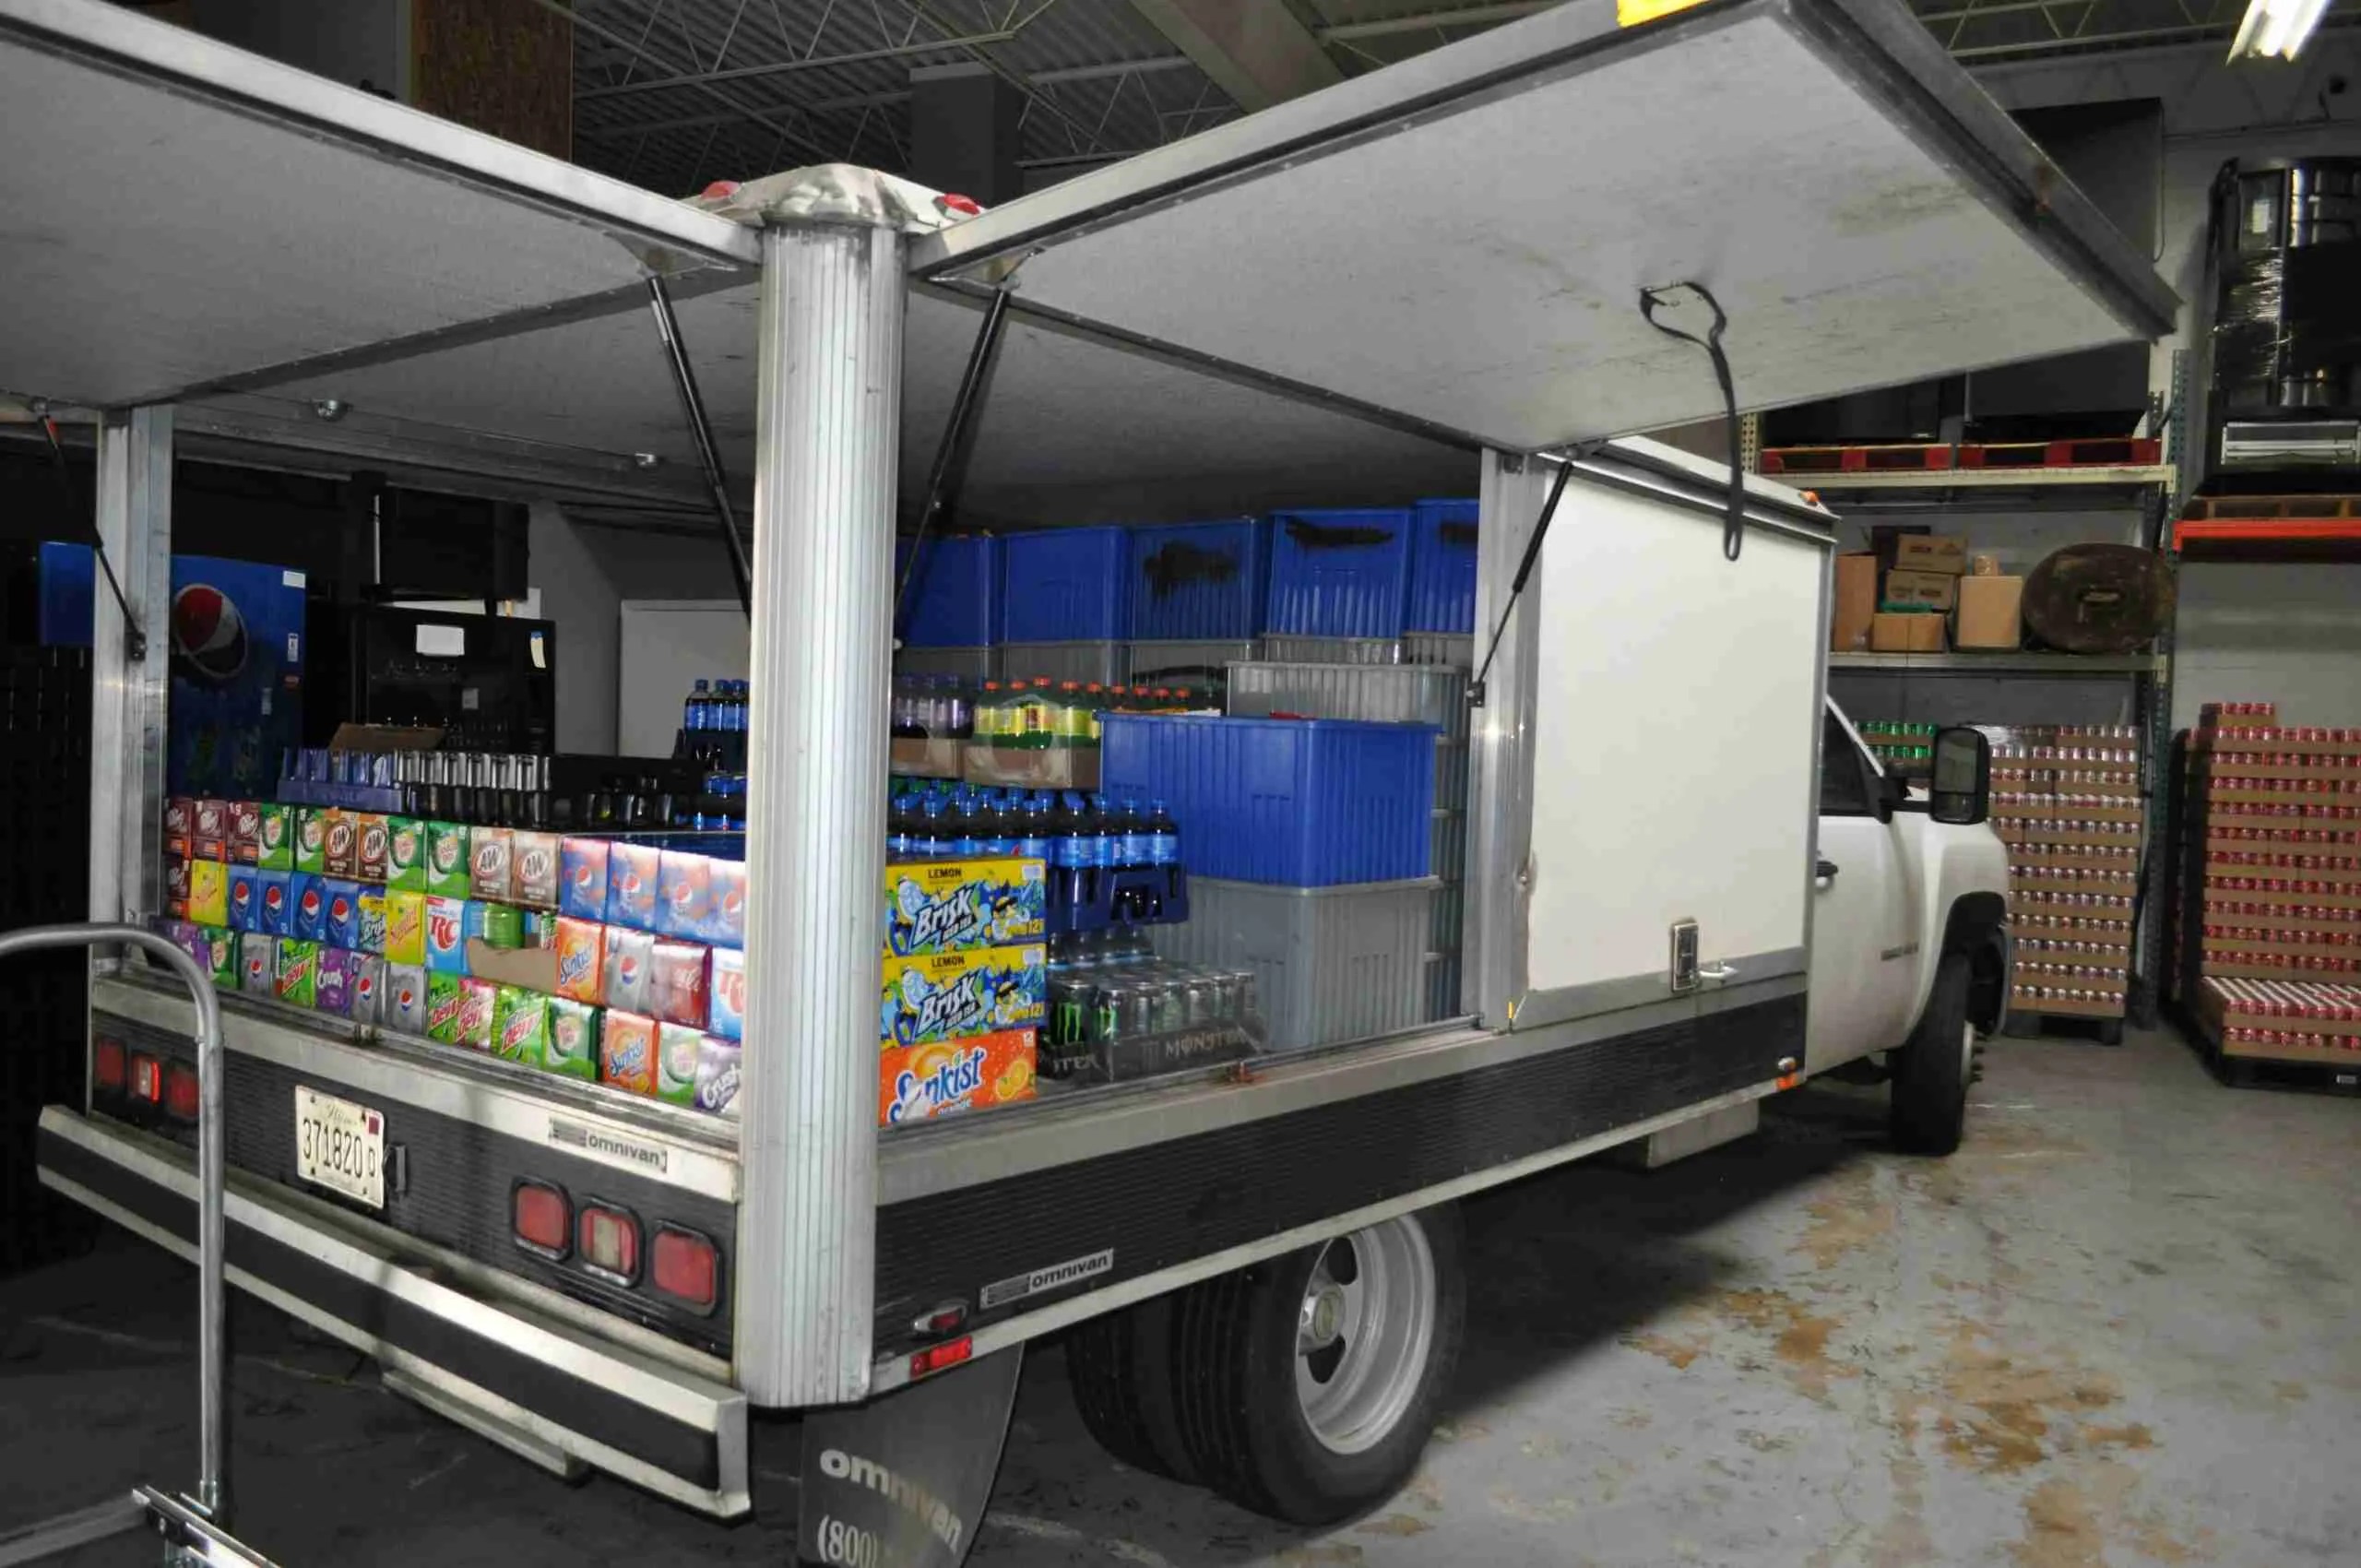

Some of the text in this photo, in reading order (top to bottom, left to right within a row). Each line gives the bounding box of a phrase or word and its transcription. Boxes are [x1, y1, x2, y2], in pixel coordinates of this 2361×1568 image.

[928, 867, 963, 879] LEMON
[931, 956, 965, 968] LEMON
[887, 1046, 987, 1123] Snkist
[303, 1116, 362, 1179] 371820
[587, 1134, 660, 1166] omnivan
[1032, 1253, 1108, 1289] omnivan
